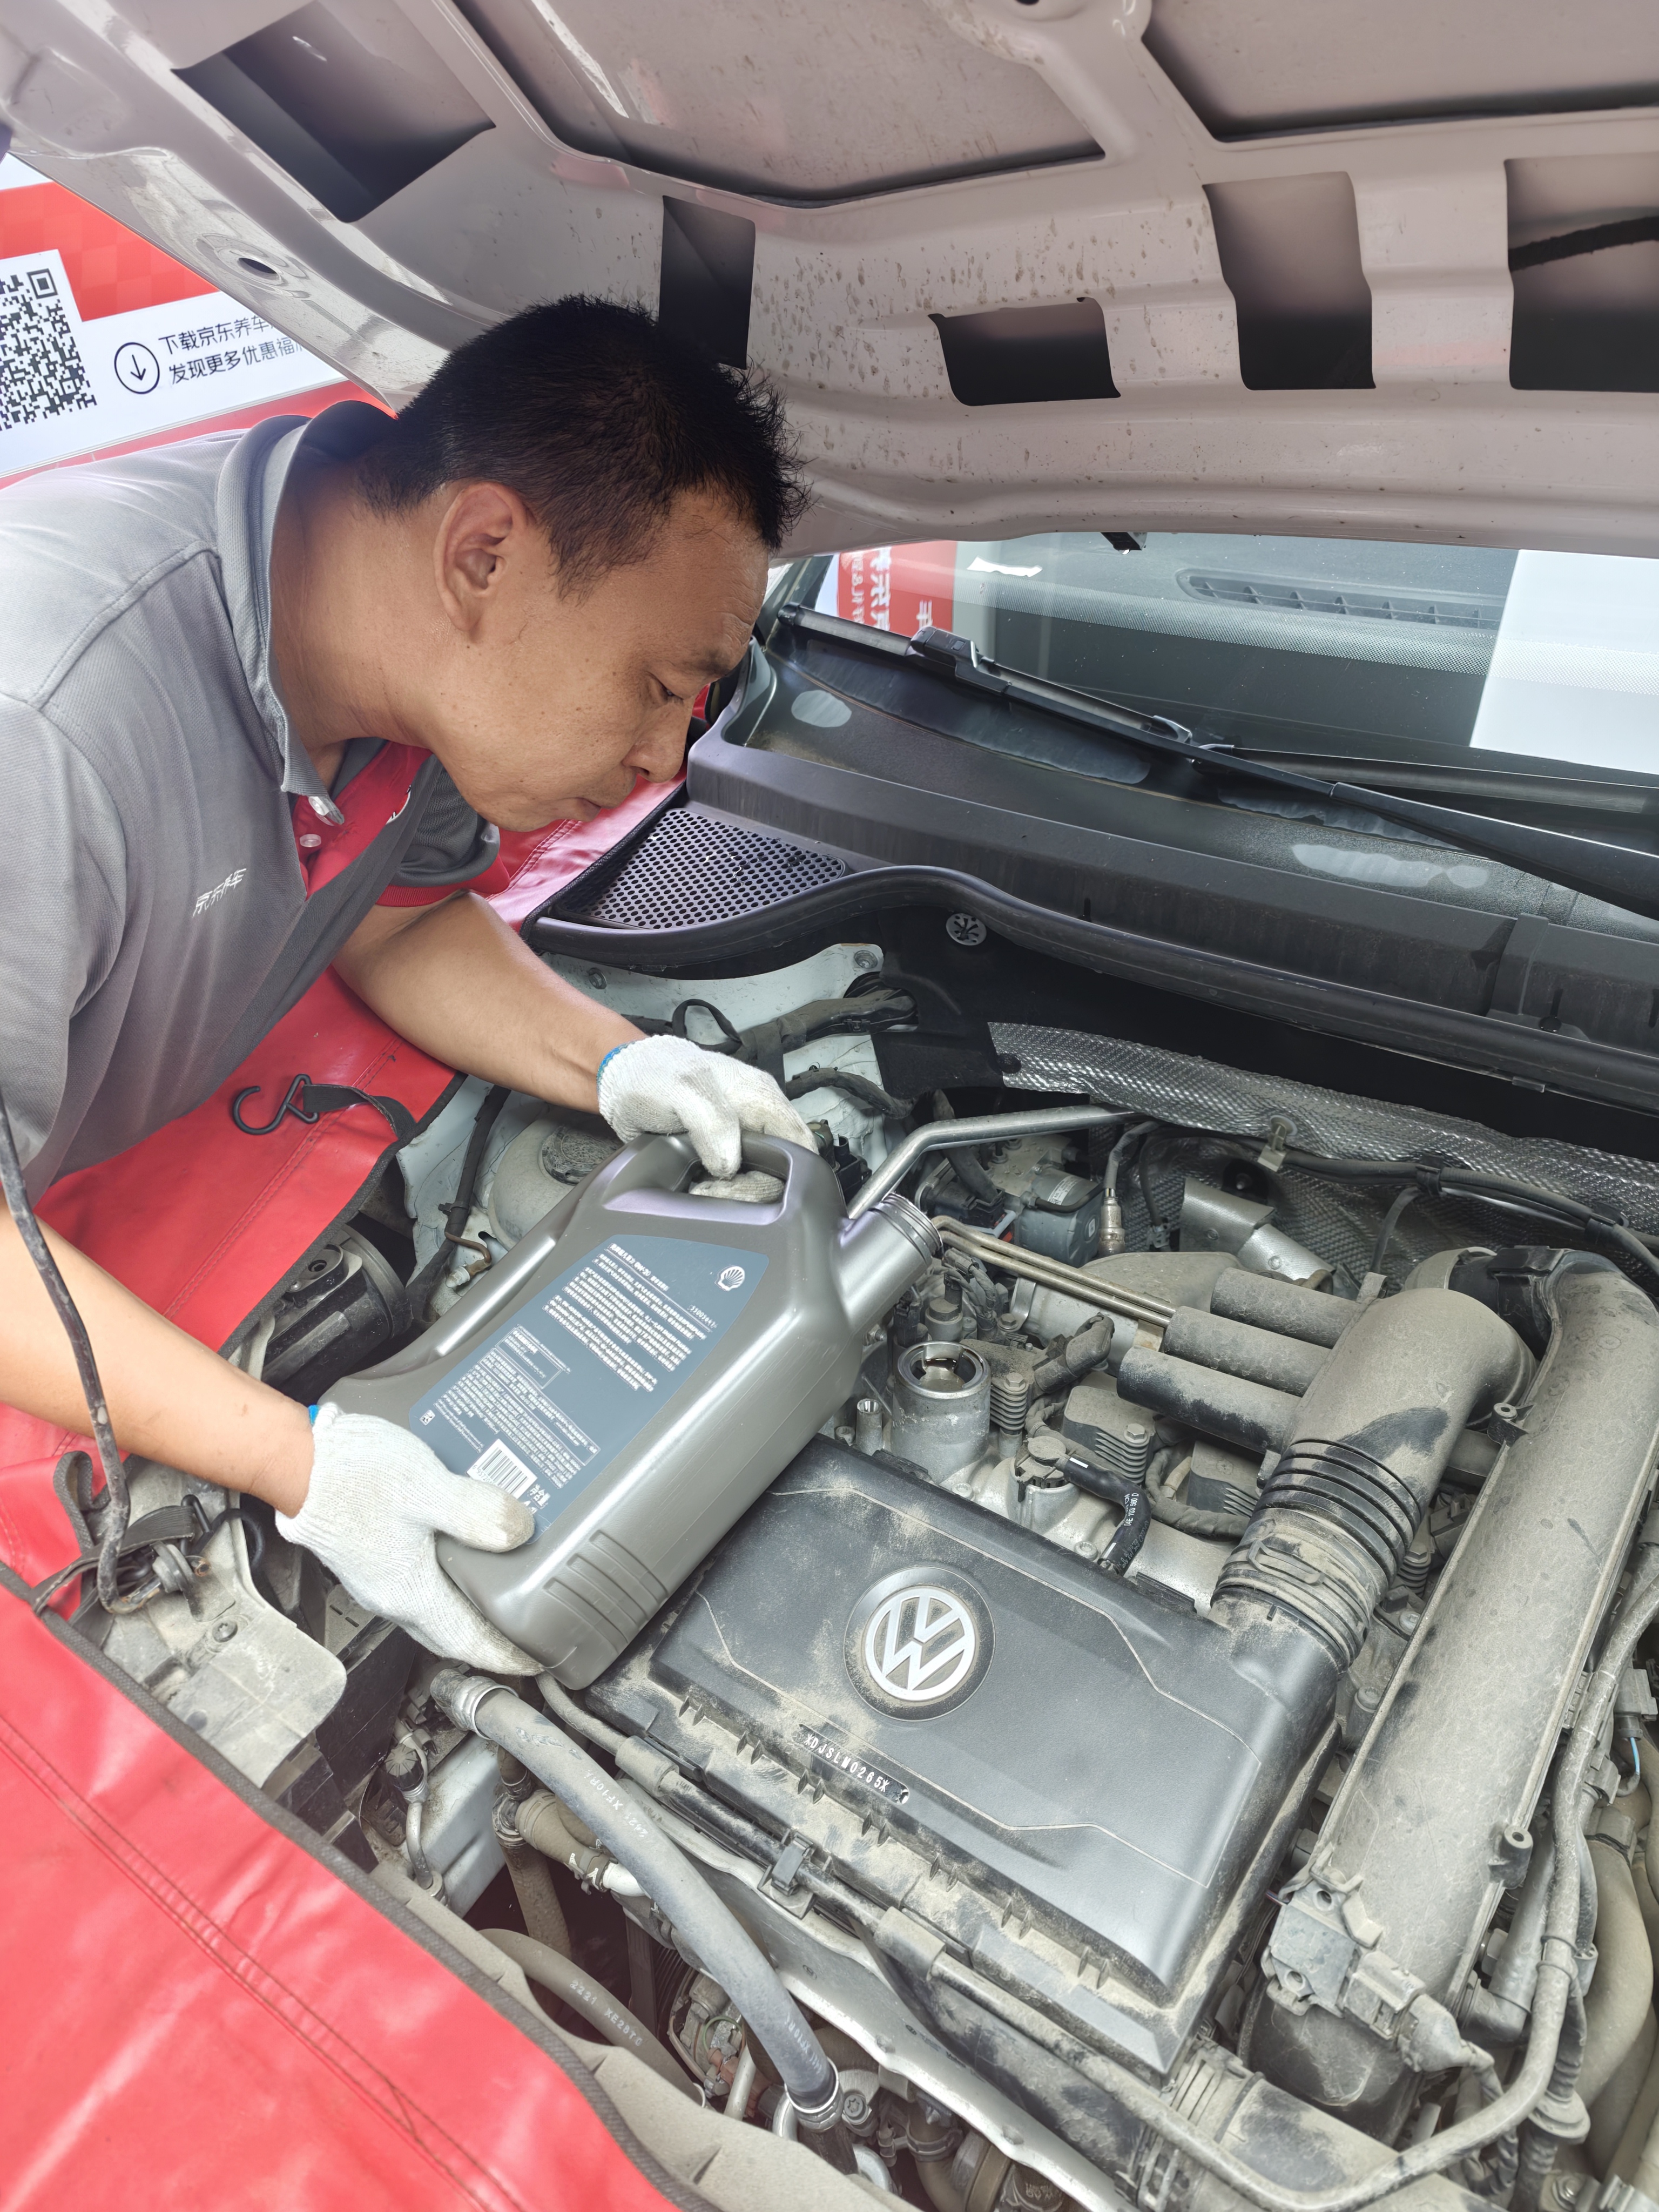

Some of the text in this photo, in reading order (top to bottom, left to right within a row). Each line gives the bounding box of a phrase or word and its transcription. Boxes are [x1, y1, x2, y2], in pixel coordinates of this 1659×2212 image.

[158, 315, 274, 355] 下载京东养车
[168, 337, 303, 385] 发现更多优惠福
[476, 1469, 493, 1483] 95720
[569, 1980, 598, 2005] 2221
